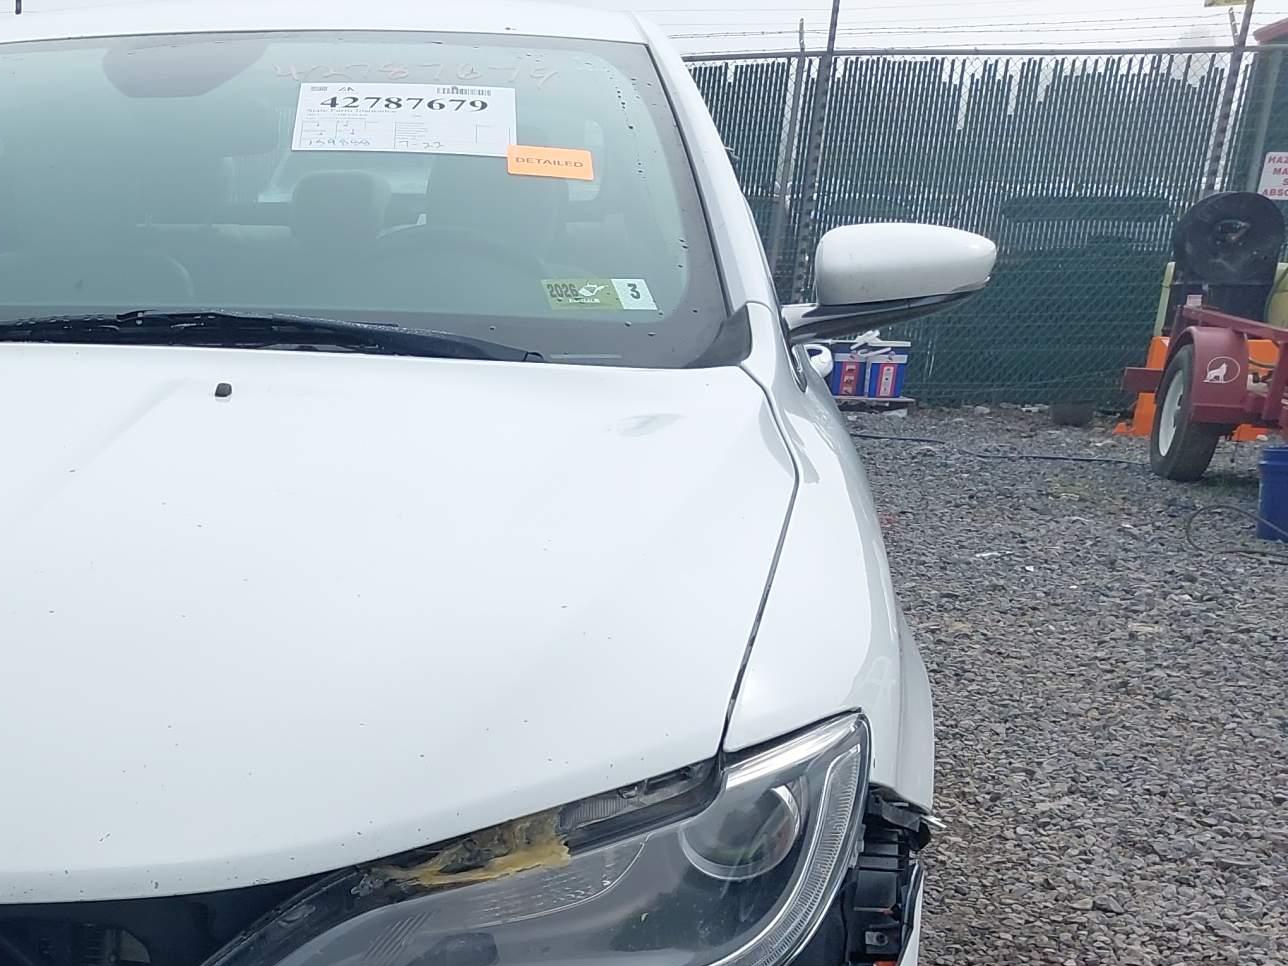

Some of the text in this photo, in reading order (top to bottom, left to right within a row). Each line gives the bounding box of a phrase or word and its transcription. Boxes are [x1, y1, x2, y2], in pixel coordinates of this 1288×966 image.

[319, 95, 489, 112] 42787679
[514, 156, 585, 168] DETAILED
[547, 283, 641, 300] 2026 3
